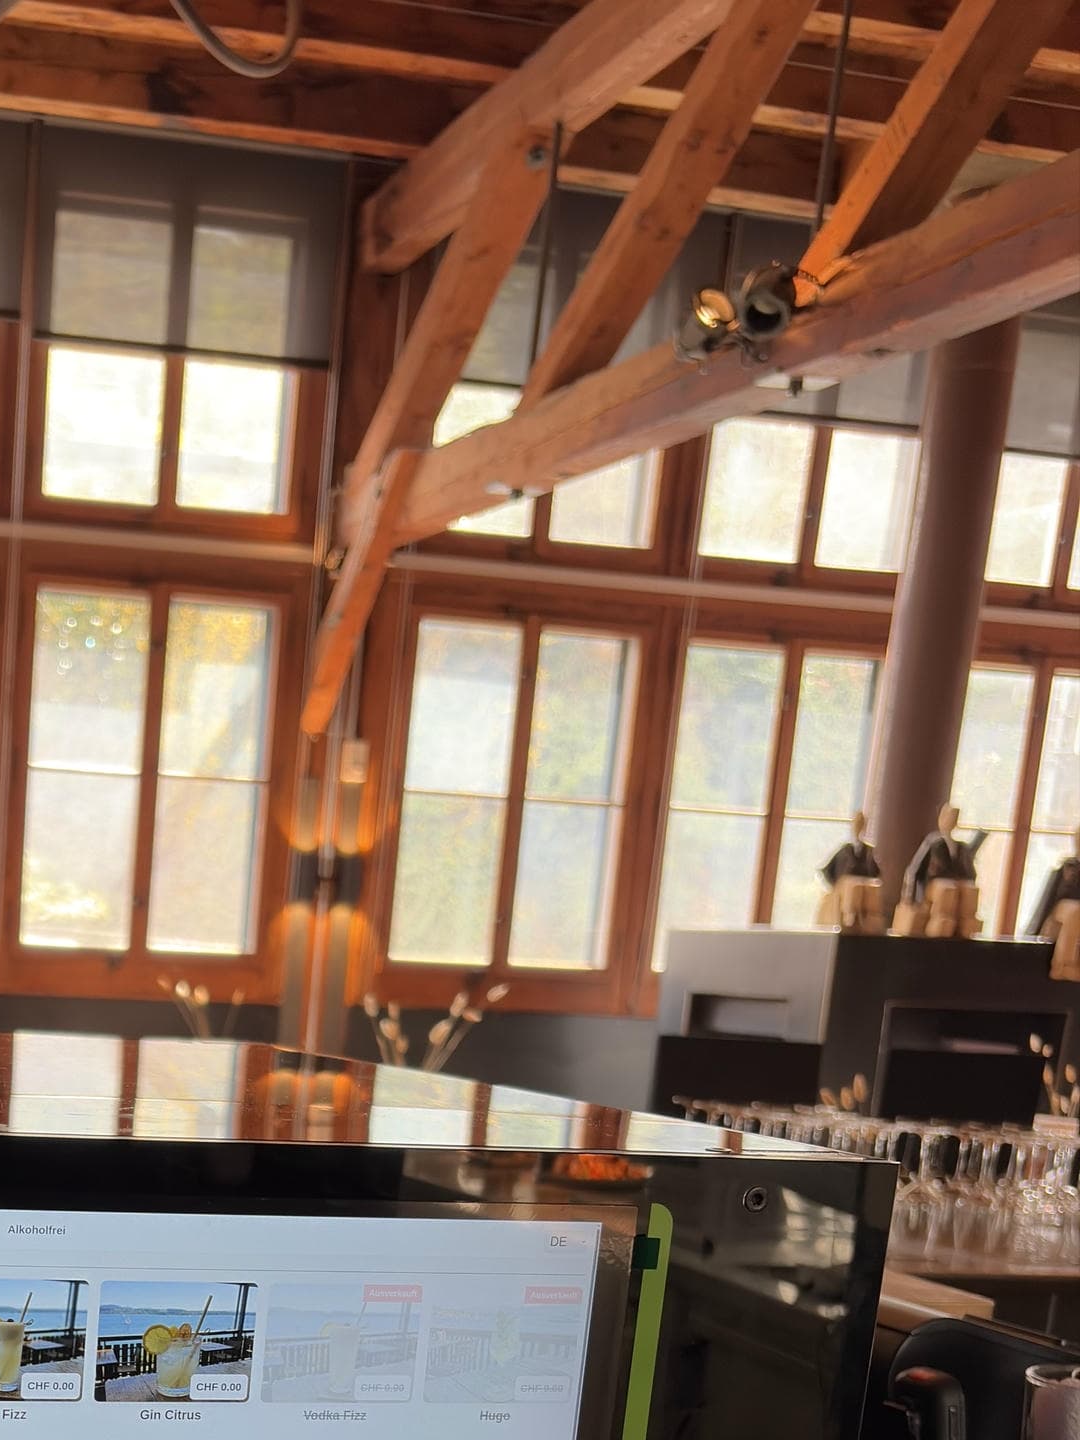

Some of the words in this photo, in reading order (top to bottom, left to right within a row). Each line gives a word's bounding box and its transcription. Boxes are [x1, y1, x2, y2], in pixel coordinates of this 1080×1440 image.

[7, 1224, 66, 1236] Alkoholfrei
[550, 1236, 567, 1247] DE
[27, 1381, 50, 1391] CHF
[53, 1381, 74, 1391] 0.00
[196, 1382, 218, 1392] CHF
[221, 1382, 242, 1392] 0.00
[2, 1409, 27, 1421] Fizz
[140, 1409, 161, 1421] Gin
[165, 1409, 201, 1421] Citrus
[304, 1410, 340, 1421] Vodka
[343, 1410, 367, 1421] Fizz
[479, 1410, 511, 1424] Hugo
